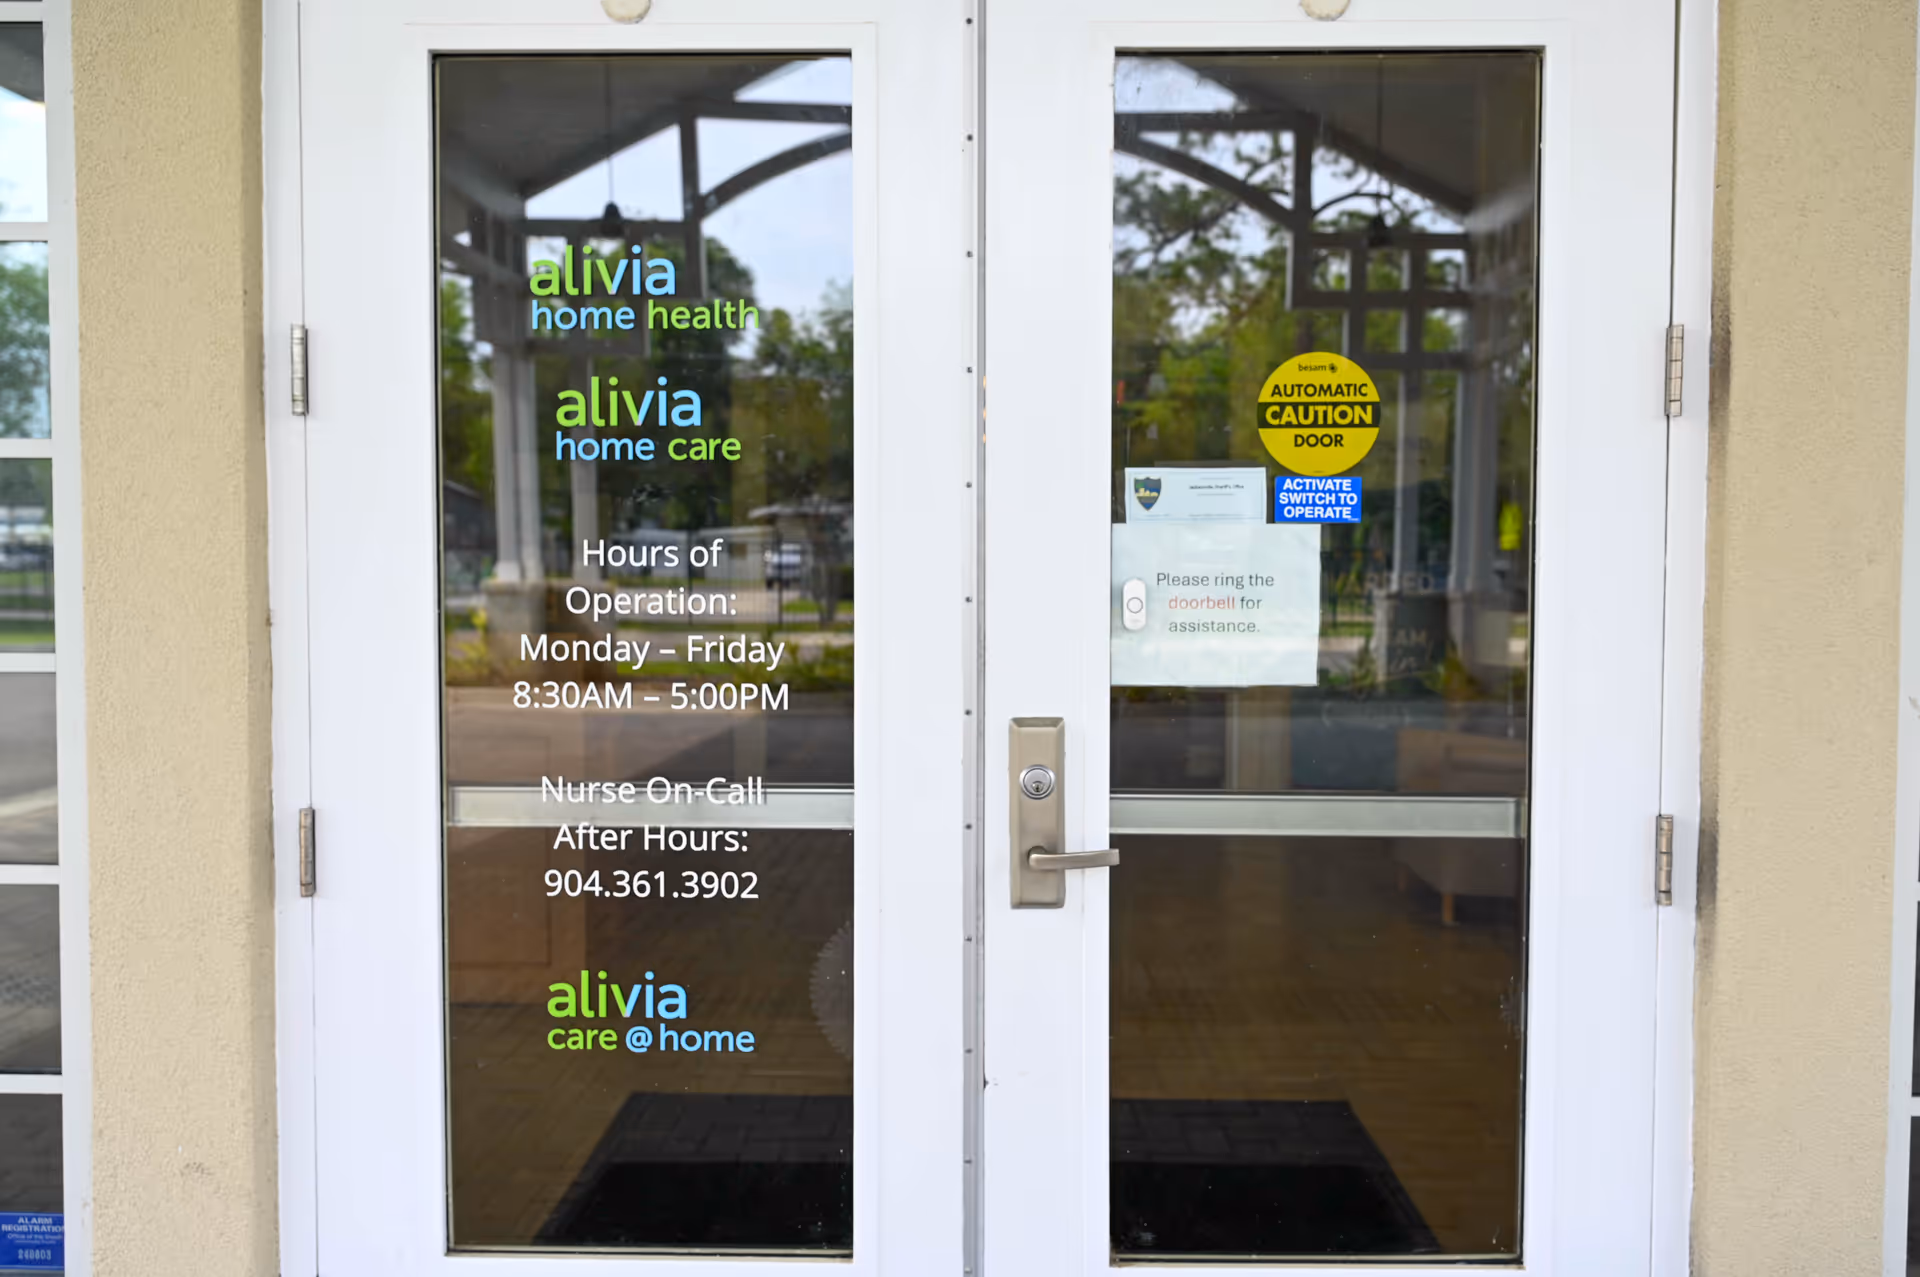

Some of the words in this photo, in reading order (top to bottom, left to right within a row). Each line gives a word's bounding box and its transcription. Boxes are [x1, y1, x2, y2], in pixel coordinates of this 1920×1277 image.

[529, 244, 676, 296] alivia
[531, 300, 635, 330] home
[648, 299, 759, 330] health
[1298, 363, 1327, 372] besam
[555, 376, 702, 427] alivia
[1271, 383, 1368, 397] AUTOMATIC
[1265, 404, 1373, 426] CAUTION
[555, 431, 655, 461] home
[667, 437, 741, 461] care
[1294, 434, 1344, 447] DOOR
[1279, 492, 1336, 505] SWITCH
[1338, 493, 1358, 505] TO
[1283, 478, 1352, 491] ACTIVATE
[1284, 506, 1351, 519] OPERATE
[582, 539, 679, 567] Hours
[689, 538, 724, 567] of
[1156, 572, 1210, 587] Please
[1214, 572, 1244, 590] ring
[1249, 573, 1275, 587] the
[565, 586, 737, 621] Operation:
[1168, 596, 1236, 610] doorbell
[1240, 596, 1263, 610] for
[1168, 619, 1261, 633] assistance.
[519, 633, 651, 670] Monday
[687, 635, 785, 671] Friday
[512, 681, 633, 709] 8:30AM
[670, 682, 789, 710] 5:00PM
[541, 775, 636, 803] Nurse
[647, 776, 764, 805] On-Call
[553, 823, 633, 850] After
[644, 825, 748, 852] Hours:
[544, 869, 759, 899] 904.361.3902
[547, 969, 687, 1019] alivia
[547, 1026, 618, 1050] care
[625, 1025, 653, 1053] @
[660, 1023, 755, 1052] home
[17, 1216, 53, 1224] ALARM
